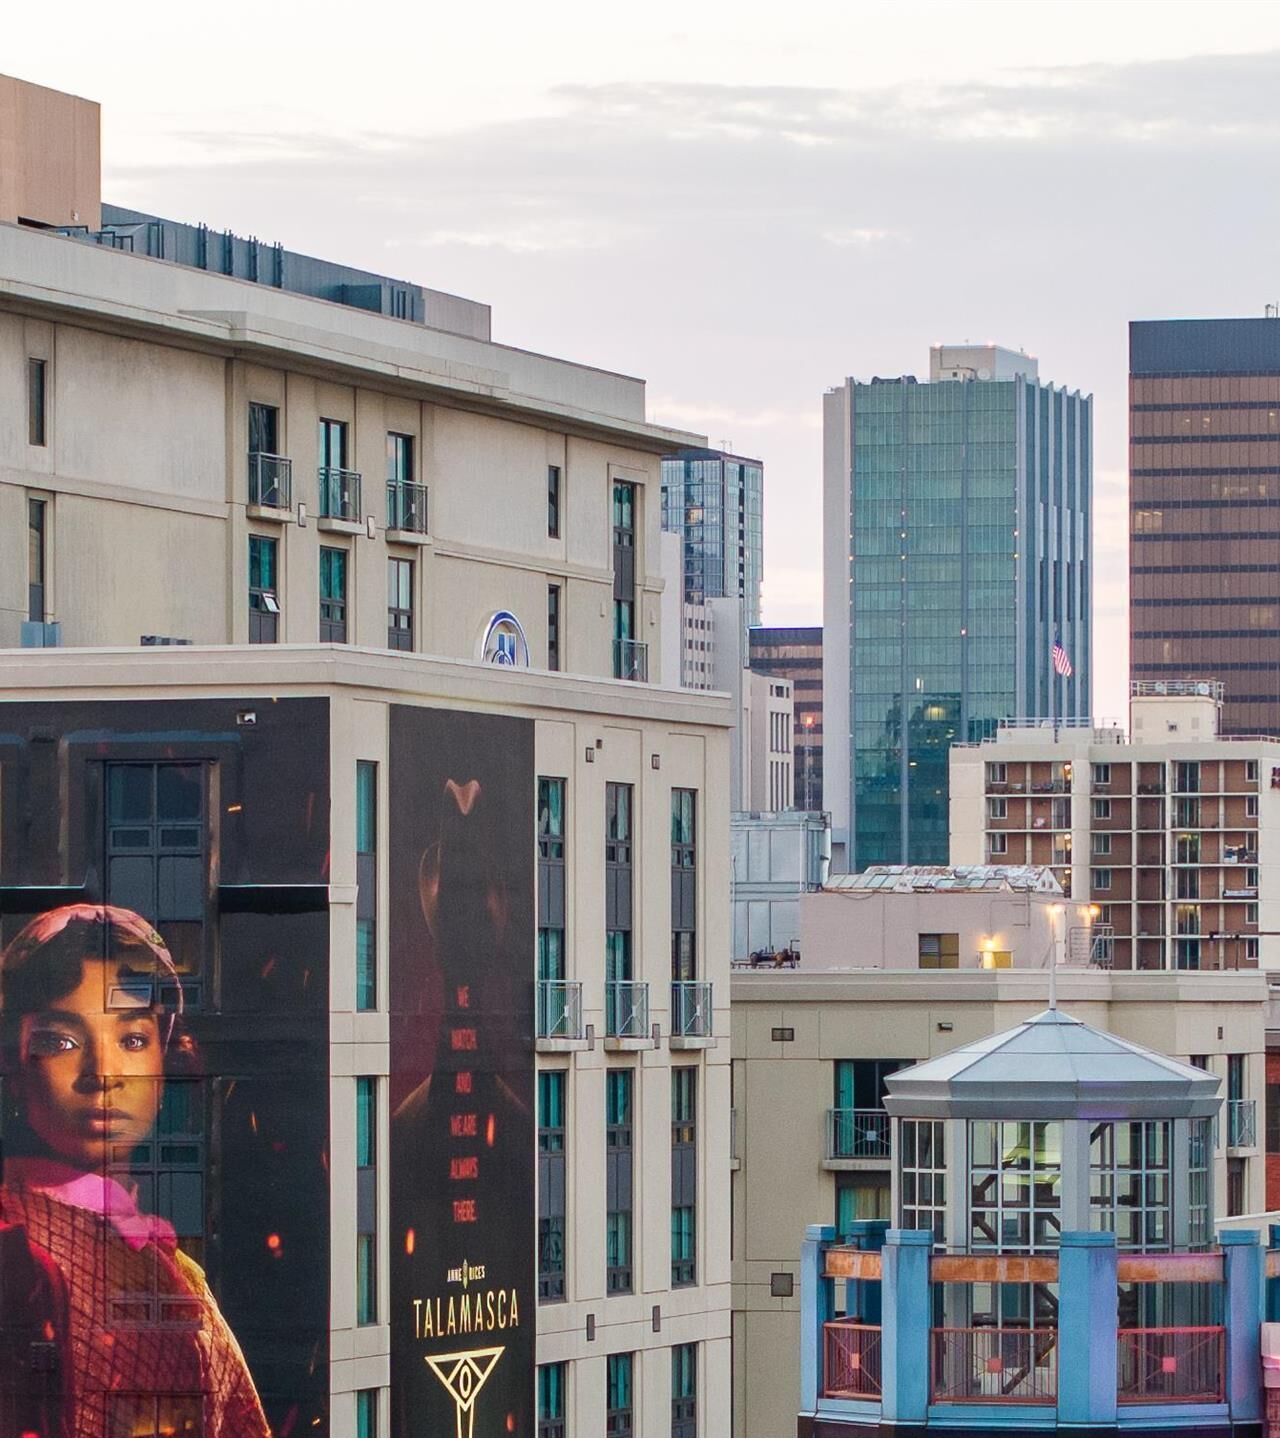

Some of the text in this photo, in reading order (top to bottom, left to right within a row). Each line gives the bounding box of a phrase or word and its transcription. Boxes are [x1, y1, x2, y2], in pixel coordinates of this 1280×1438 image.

[457, 986, 469, 1008] WE
[455, 1071, 472, 1093] AND
[450, 1115, 477, 1136] WE ARE
[449, 1156, 478, 1180] ALWAYS
[413, 1288, 519, 1339] TALAMASCA
